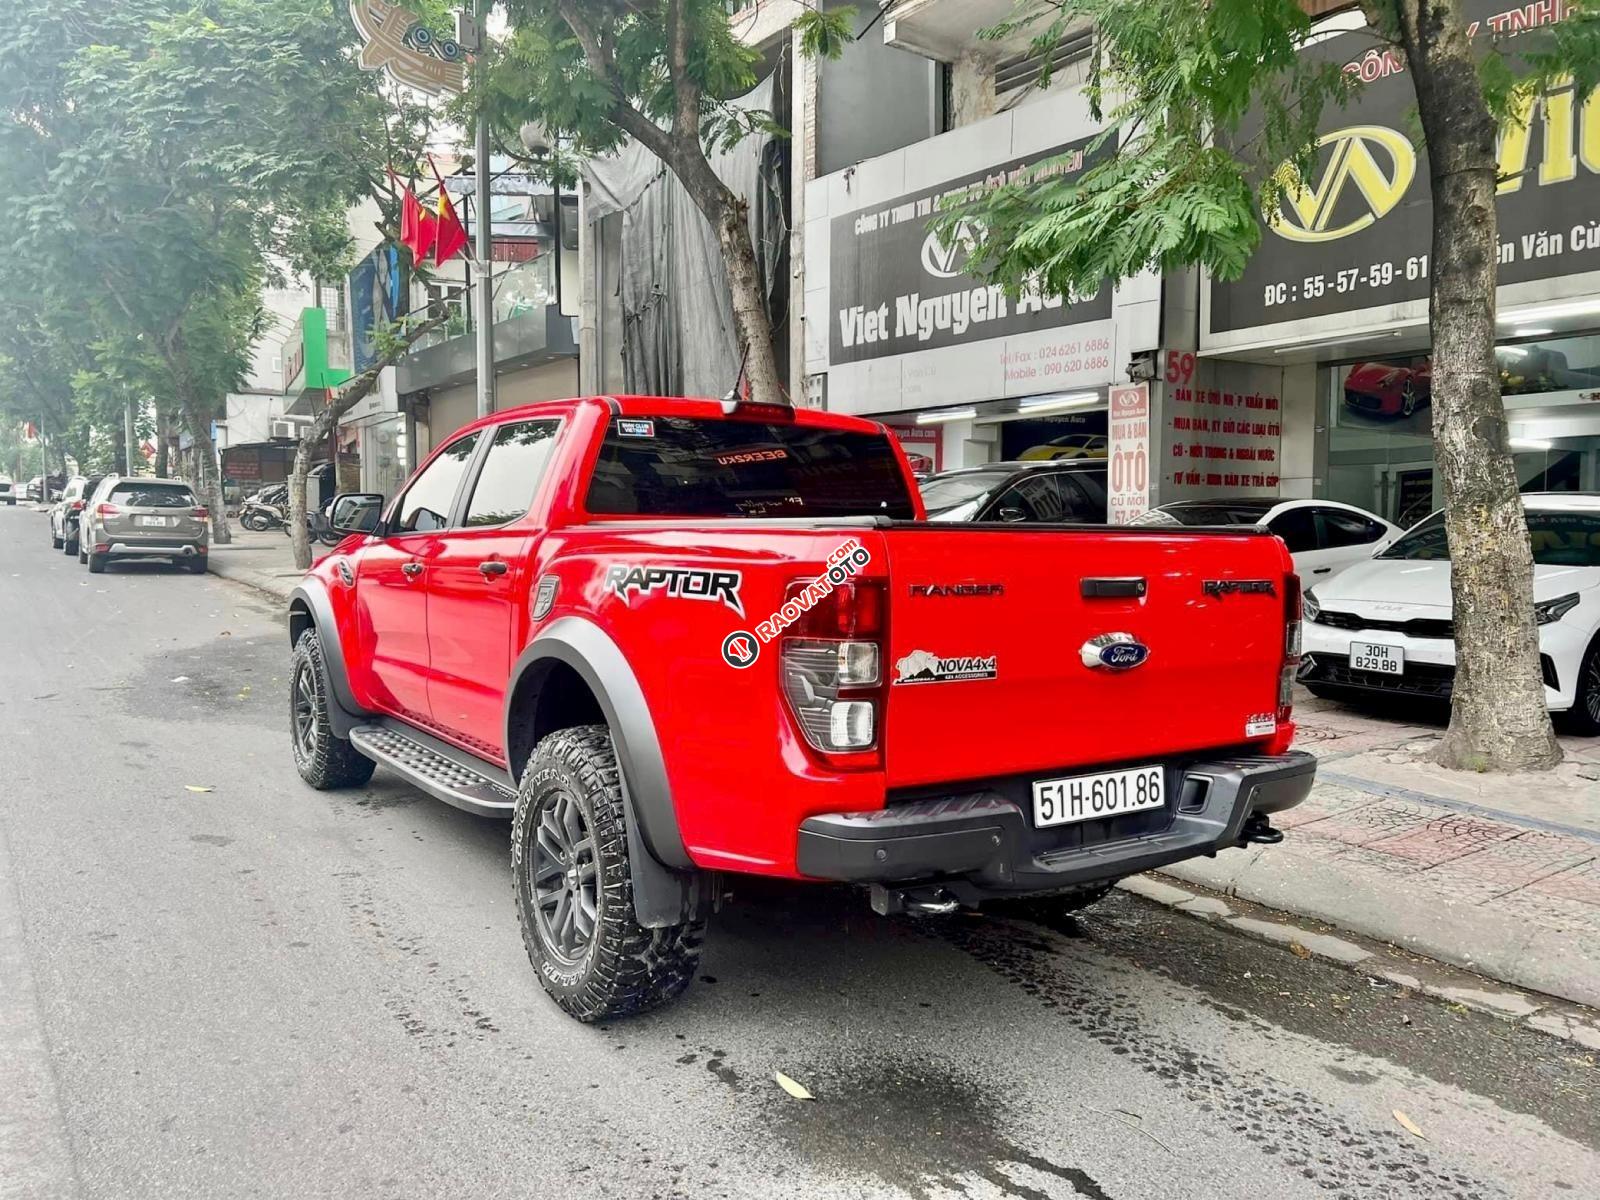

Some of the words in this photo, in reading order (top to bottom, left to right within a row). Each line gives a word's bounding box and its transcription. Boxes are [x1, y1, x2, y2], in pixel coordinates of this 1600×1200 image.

[1341, 50, 1405, 89] CÔN
[1521, 230, 1563, 260] Văn
[1264, 281, 1288, 306] ĐC
[839, 301, 889, 348] Viet
[895, 283, 1008, 342] Nguyen
[1039, 346, 1057, 360] 024
[1059, 342, 1081, 357] 6261
[1085, 338, 1109, 352] 6886
[1005, 366, 1036, 381] Mobile
[1044, 362, 1062, 376] 090
[1064, 359, 1081, 373] 620
[1084, 356, 1109, 370] 6886
[1166, 350, 1194, 384] 59
[1173, 416, 1191, 431] MUA
[1112, 442, 1146, 493] ÔTÔ
[604, 564, 746, 619] RAPTOR
[909, 584, 1004, 596] RANGER
[1203, 579, 1276, 601] RAPTOR
[1110, 645, 1138, 663] Ford
[1355, 656, 1397, 672] 829.88
[1365, 645, 1388, 658] 30H
[936, 657, 996, 673] NOVA4x4
[1039, 770, 1161, 822] 51H-601.86
[515, 767, 570, 865] GOODYEAR
